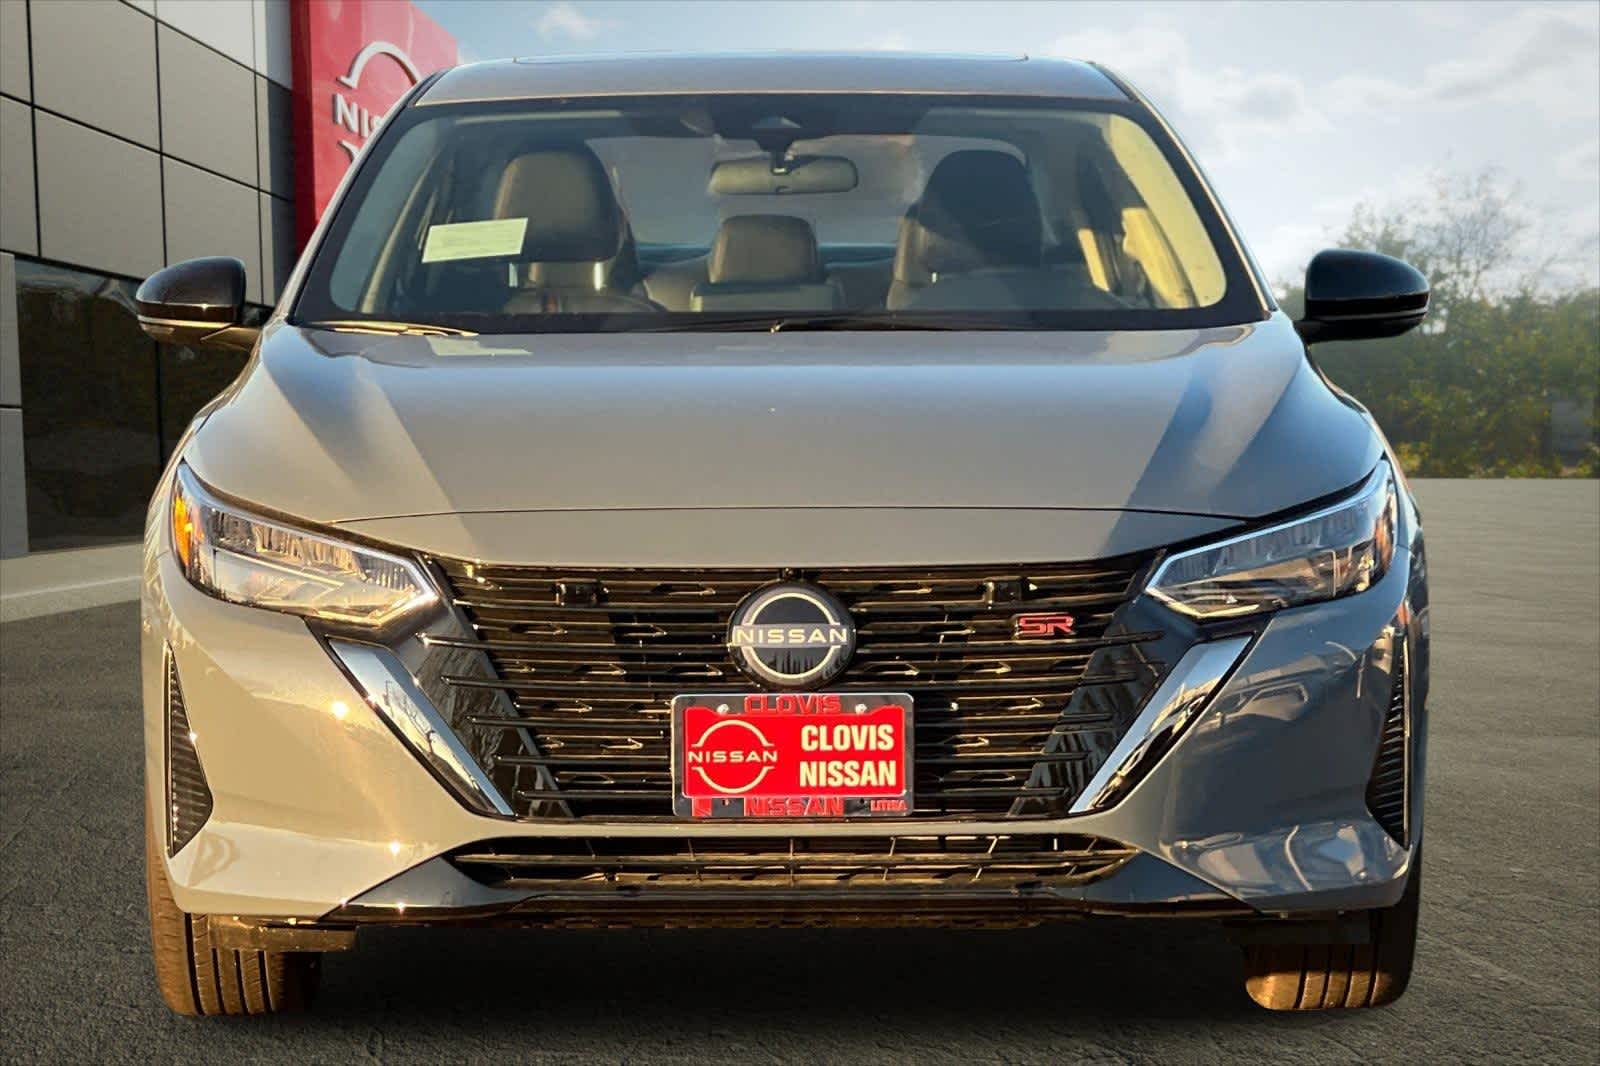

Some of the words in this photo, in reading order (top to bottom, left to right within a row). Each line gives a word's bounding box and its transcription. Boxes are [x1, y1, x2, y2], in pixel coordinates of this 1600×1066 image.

[1019, 615, 1074, 634] SR
[736, 628, 848, 644] NISSAN
[744, 694, 842, 714] CLOVIS
[801, 724, 894, 751] CLOVIS
[688, 750, 778, 763] NISSAN
[799, 760, 897, 787] NISSAN
[744, 798, 843, 817] NISSAN
